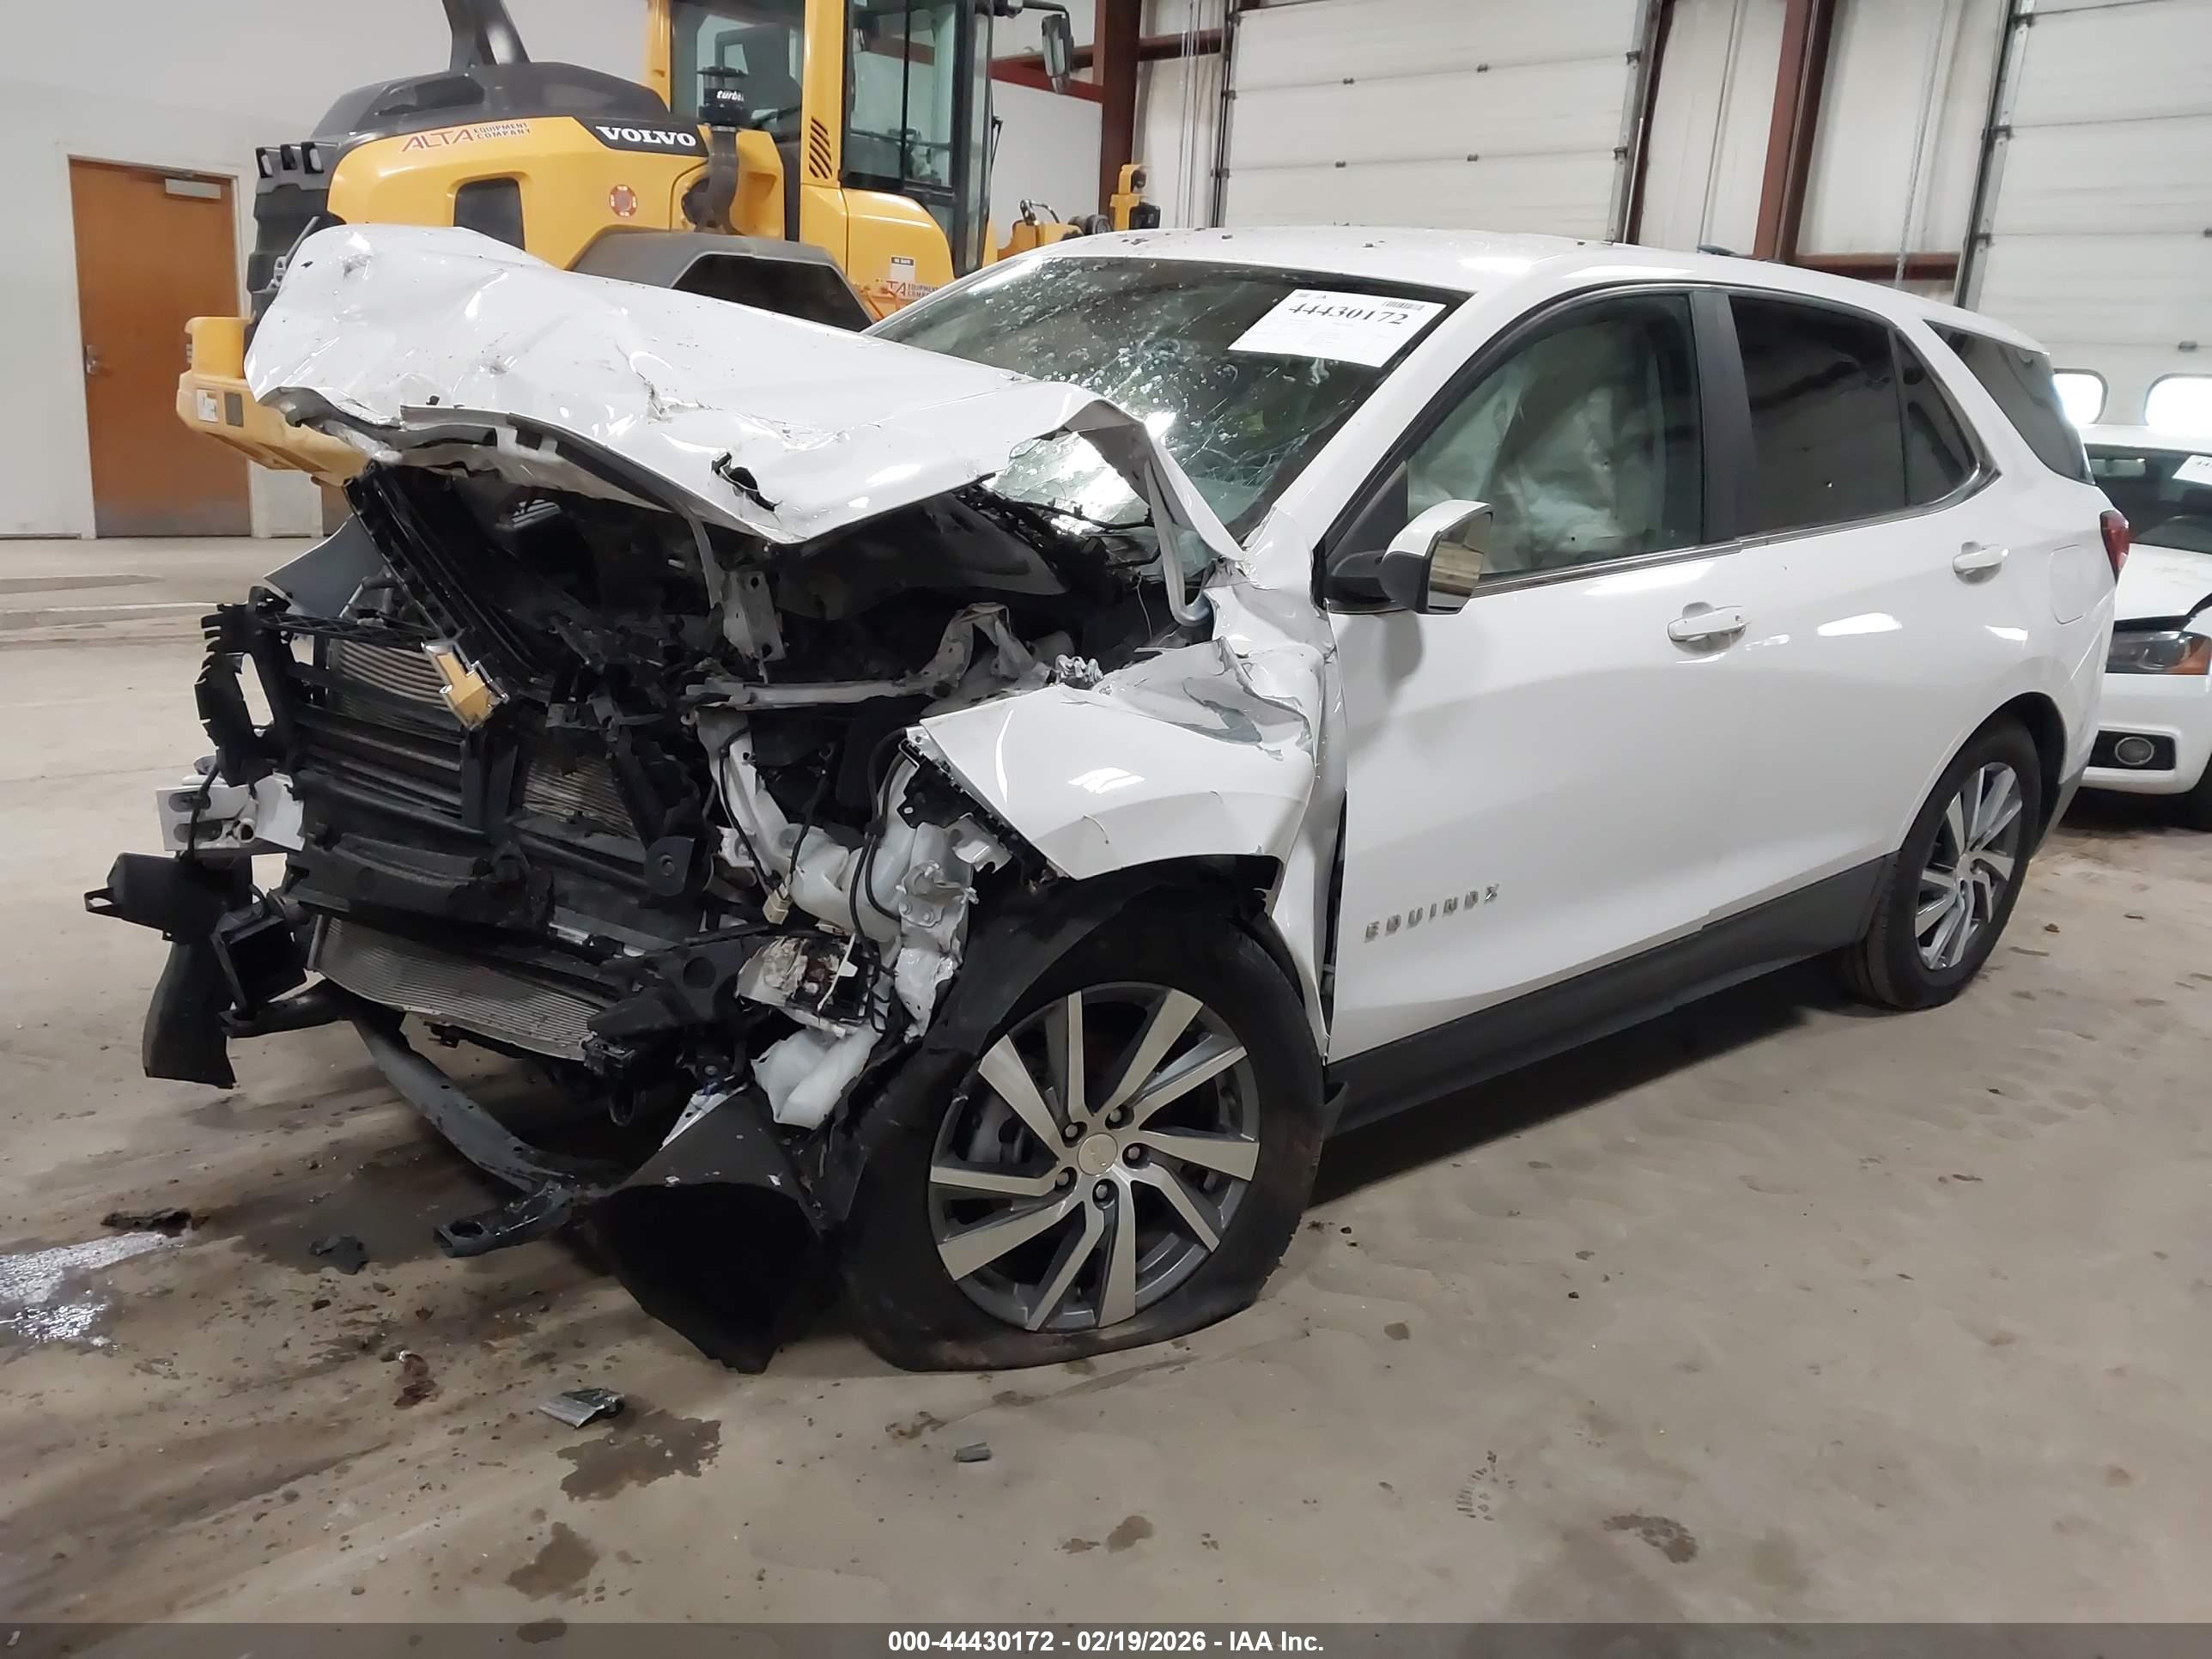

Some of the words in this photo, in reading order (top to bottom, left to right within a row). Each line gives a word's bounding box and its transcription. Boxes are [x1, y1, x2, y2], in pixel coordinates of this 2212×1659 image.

[473, 122, 528, 134] EQUIPMENT
[477, 129, 531, 139] COMPANY
[595, 125, 696, 147] VOLVO
[401, 129, 475, 153] ALTA
[1288, 303, 1409, 325] 44430172
[1364, 884, 1500, 942] EQUINOX
